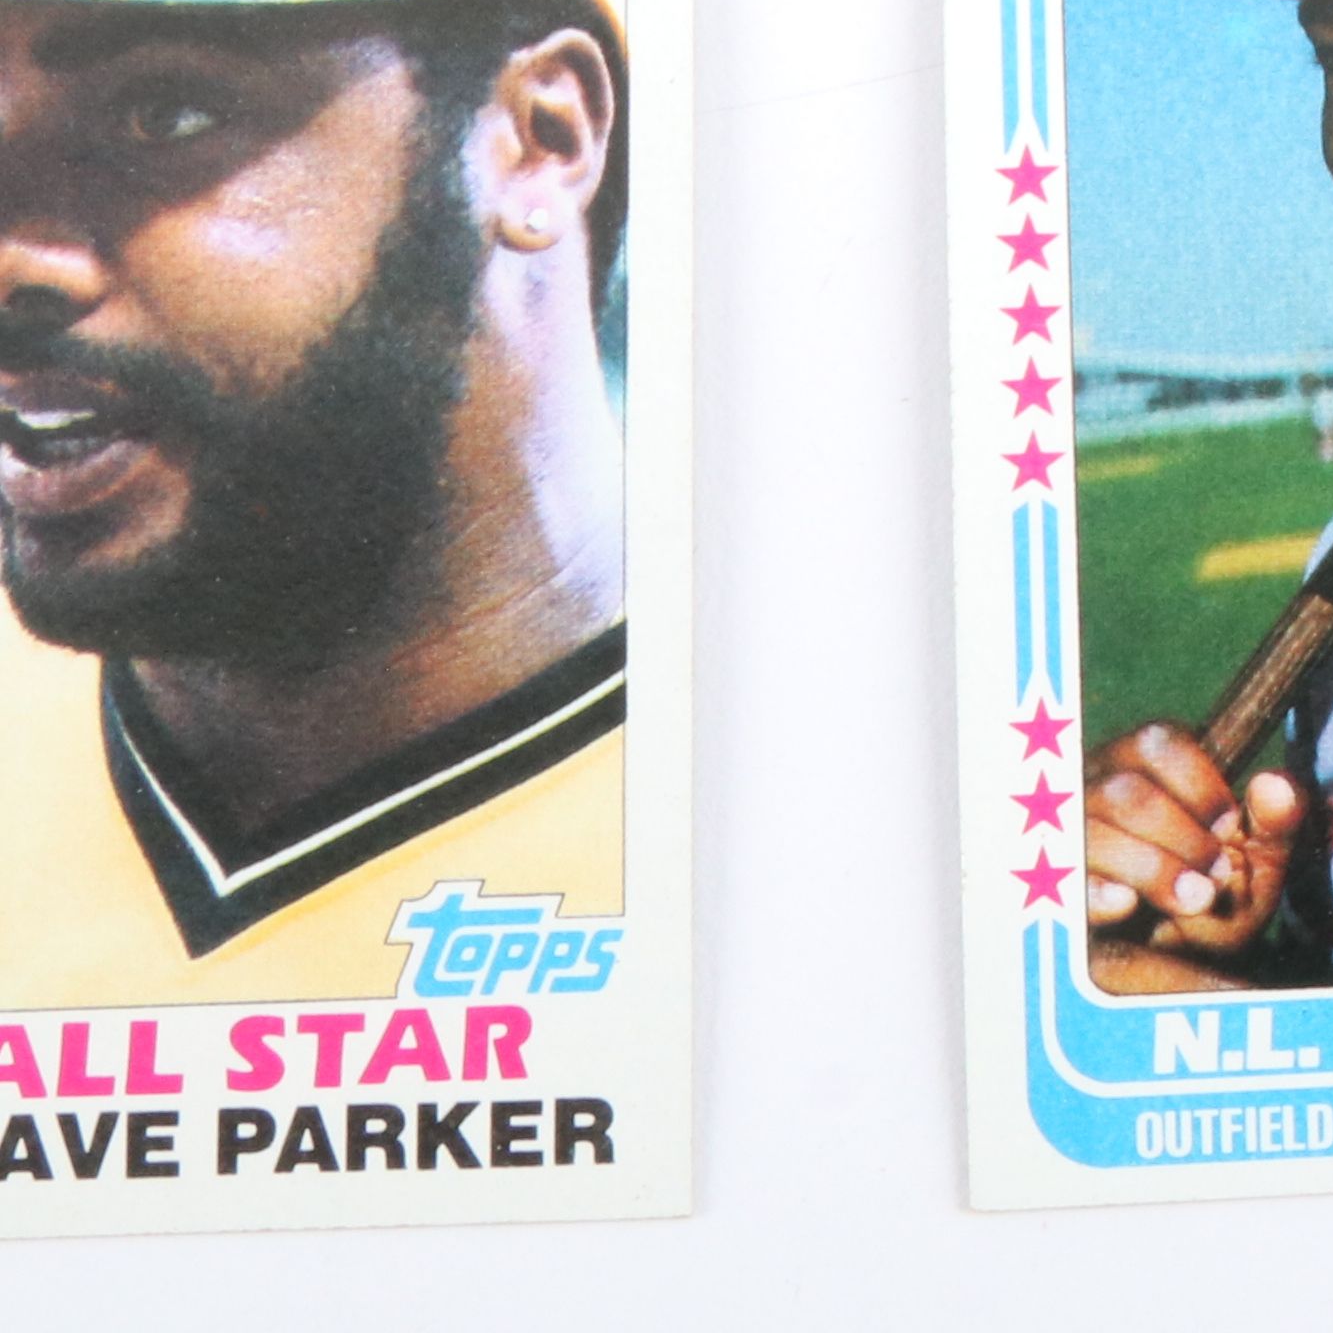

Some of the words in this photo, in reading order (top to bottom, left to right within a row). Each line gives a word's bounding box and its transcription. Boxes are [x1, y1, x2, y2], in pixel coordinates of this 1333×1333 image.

[407, 892, 624, 998] topps
[0, 1020, 184, 1099] ALL
[226, 1004, 533, 1092] STAR
[1153, 1006, 1321, 1076] N.L.
[0, 1111, 180, 1181] AVE
[216, 1096, 617, 1177] PARKER
